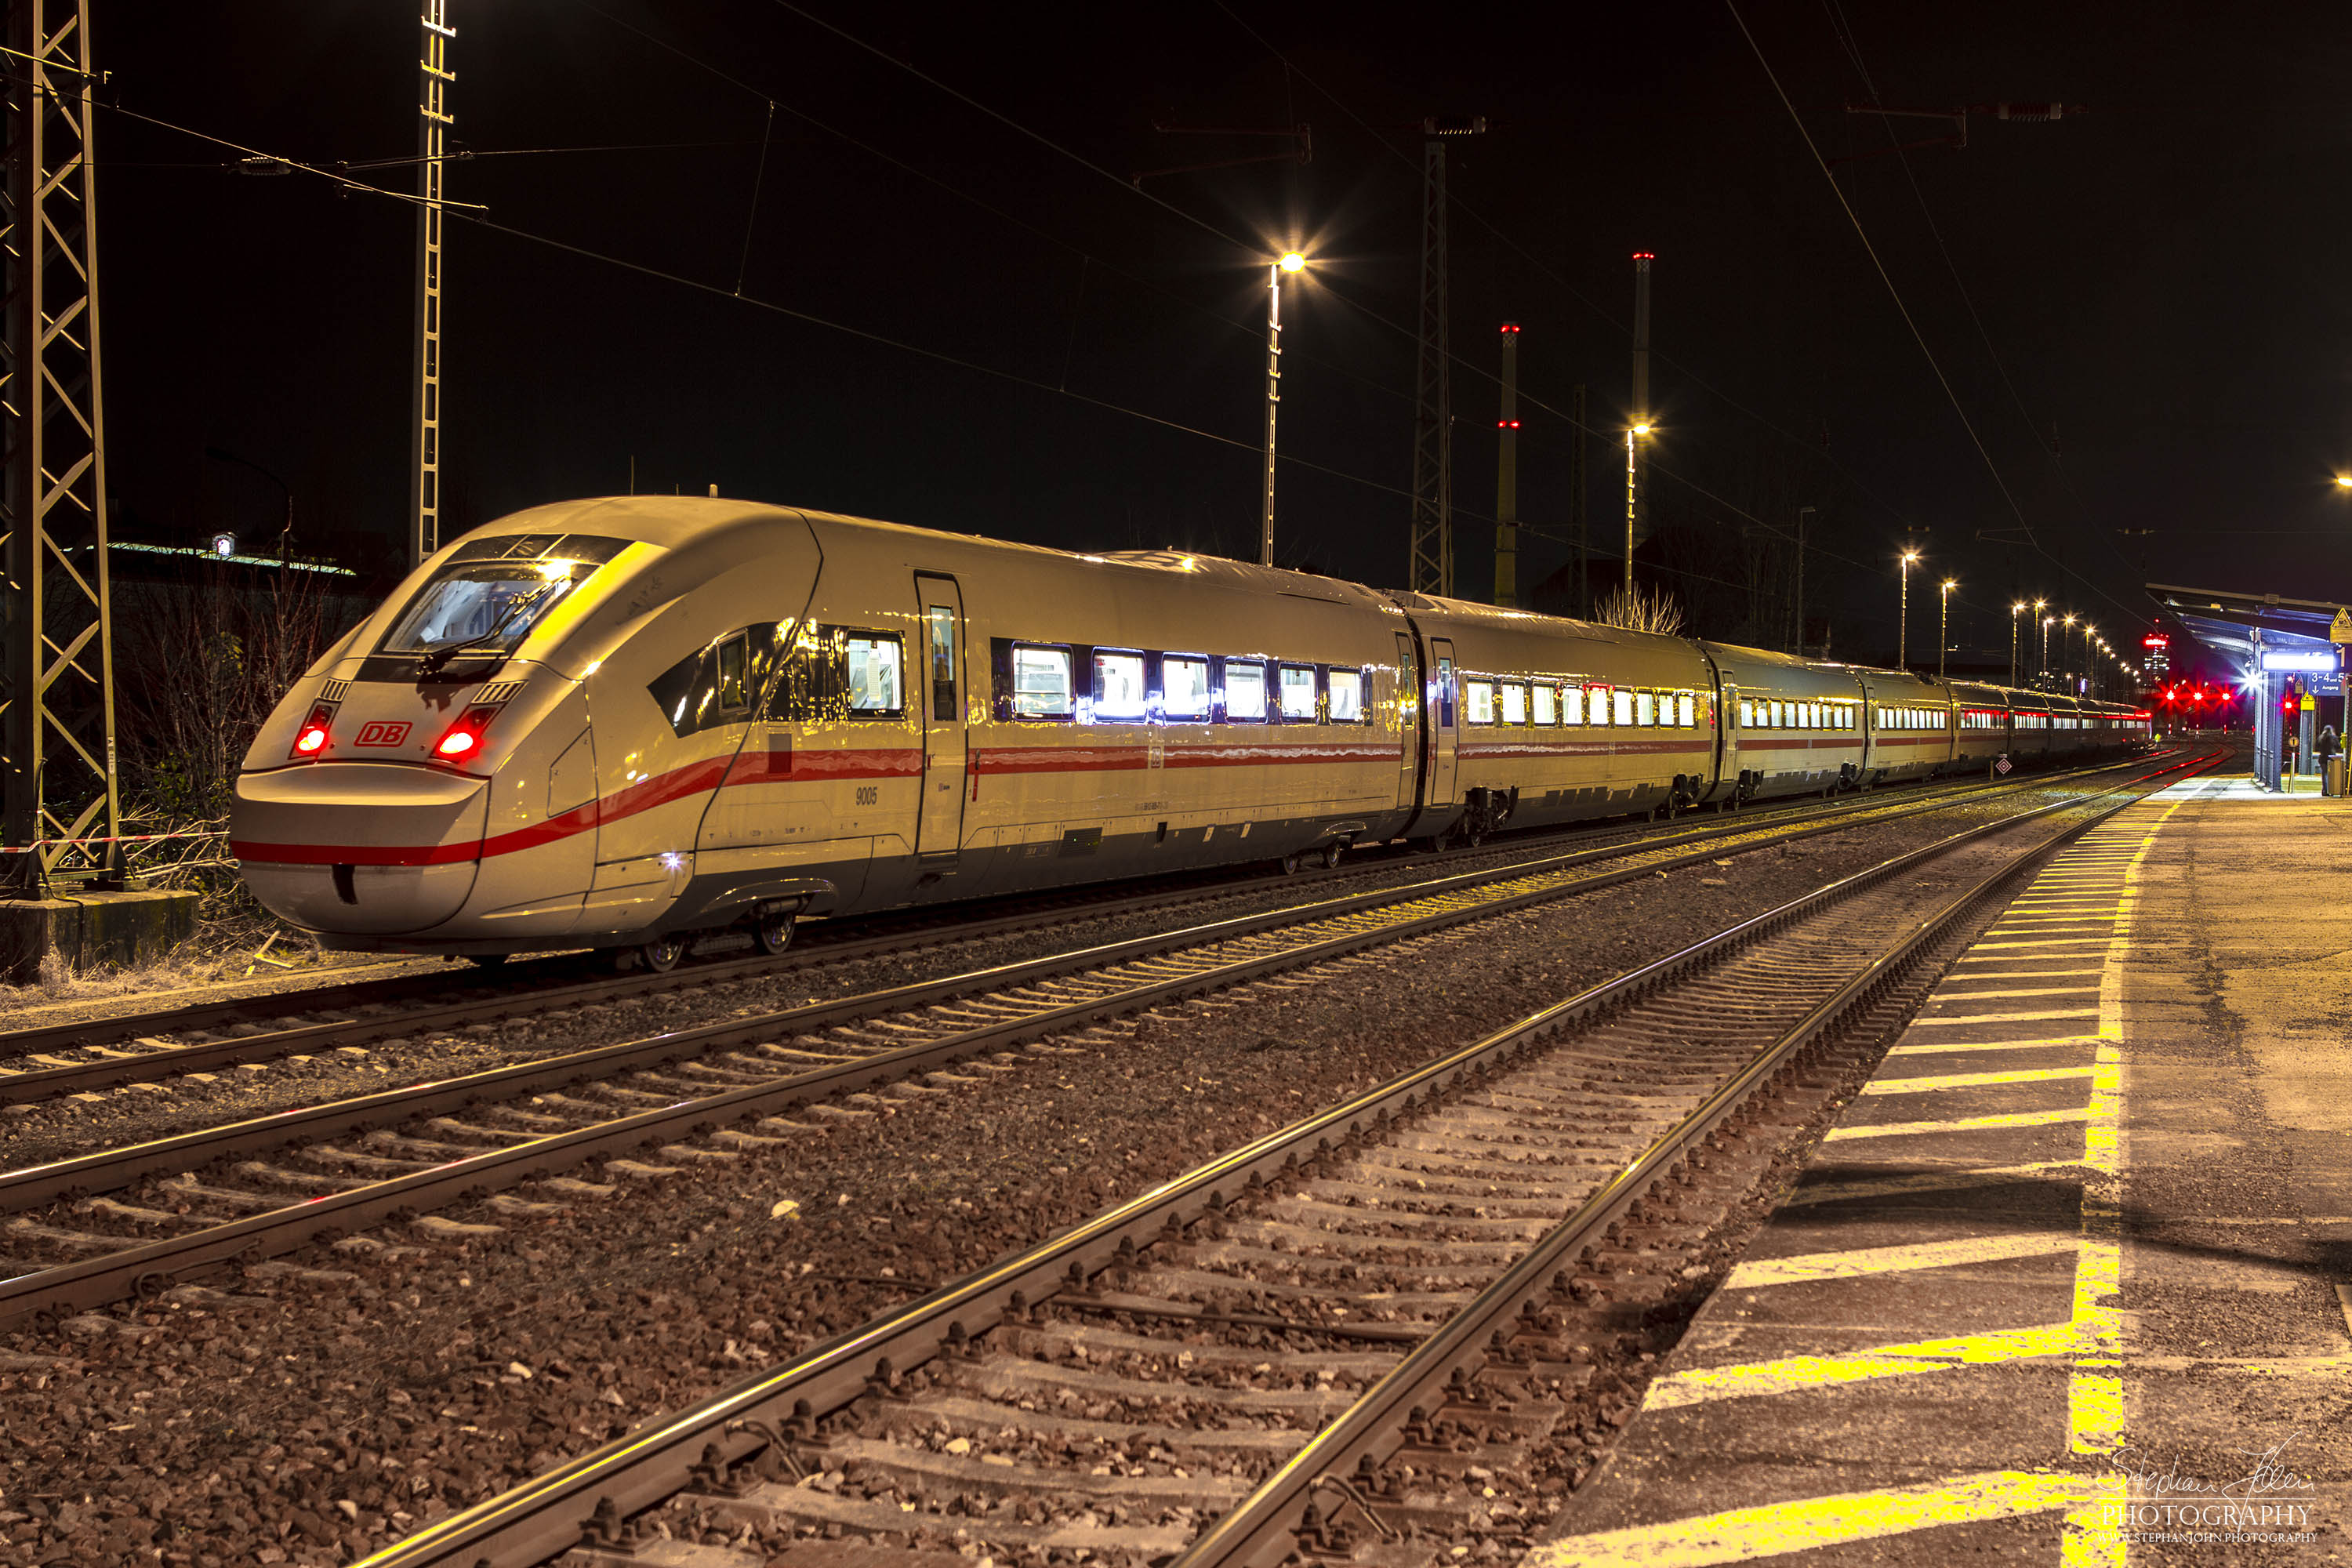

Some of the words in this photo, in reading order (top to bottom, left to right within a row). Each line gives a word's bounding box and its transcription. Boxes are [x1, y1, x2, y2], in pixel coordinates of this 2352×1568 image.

[2336, 647, 2345, 667] 1
[2338, 673, 2344, 682] 5
[361, 724, 405, 743] DB
[856, 786, 877, 805] 9005
